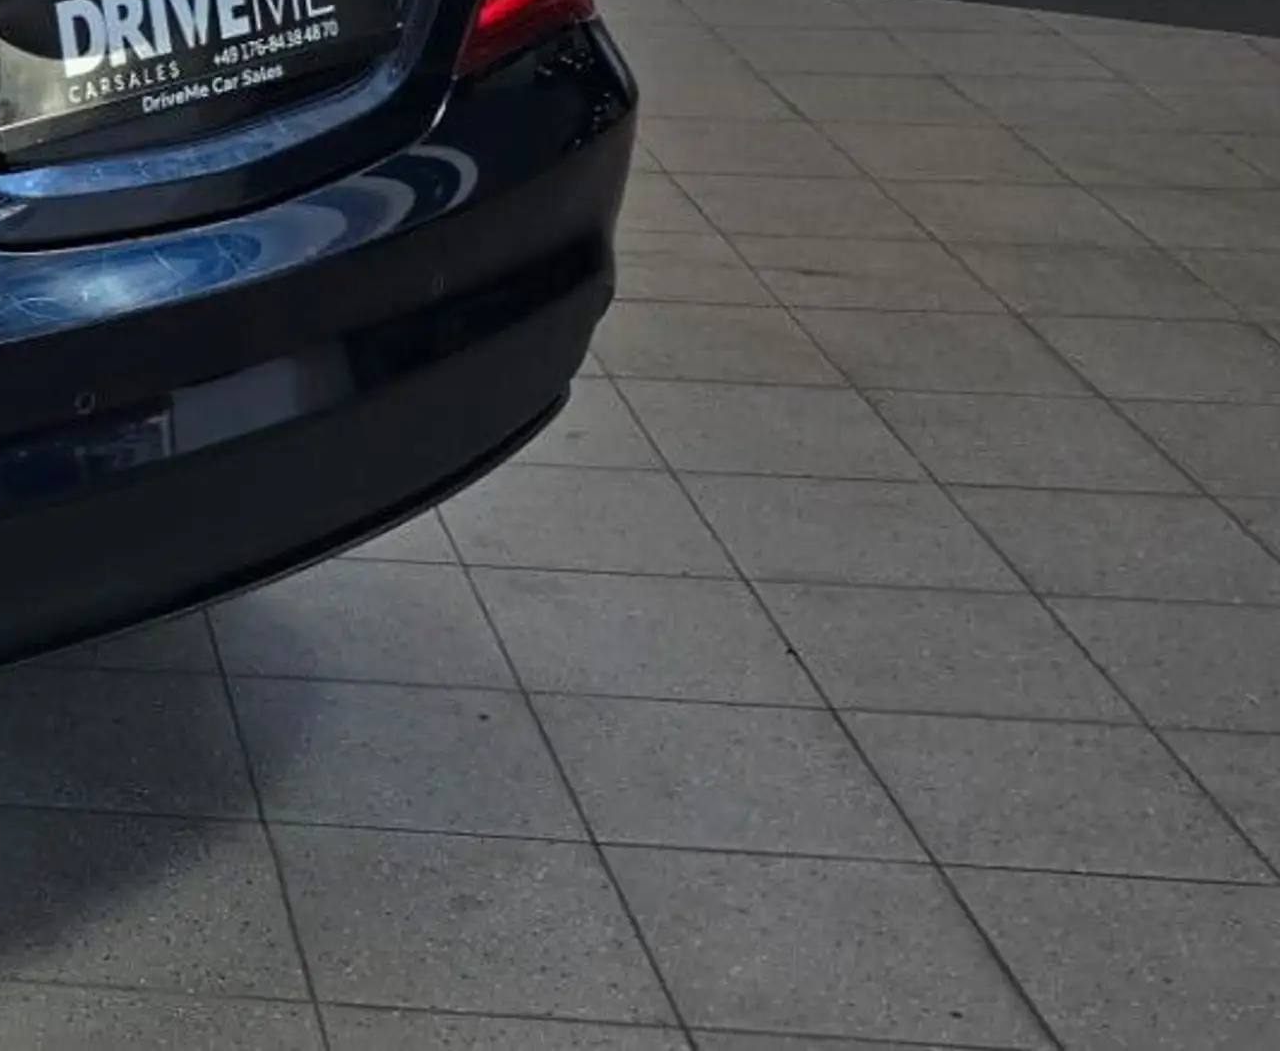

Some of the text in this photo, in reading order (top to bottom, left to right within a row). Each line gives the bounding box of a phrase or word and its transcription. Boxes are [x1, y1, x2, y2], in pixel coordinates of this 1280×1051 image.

[213, 45, 239, 66] +49
[68, 60, 180, 103] CARSALES
[142, 64, 284, 113] DriveMe Car Sales
